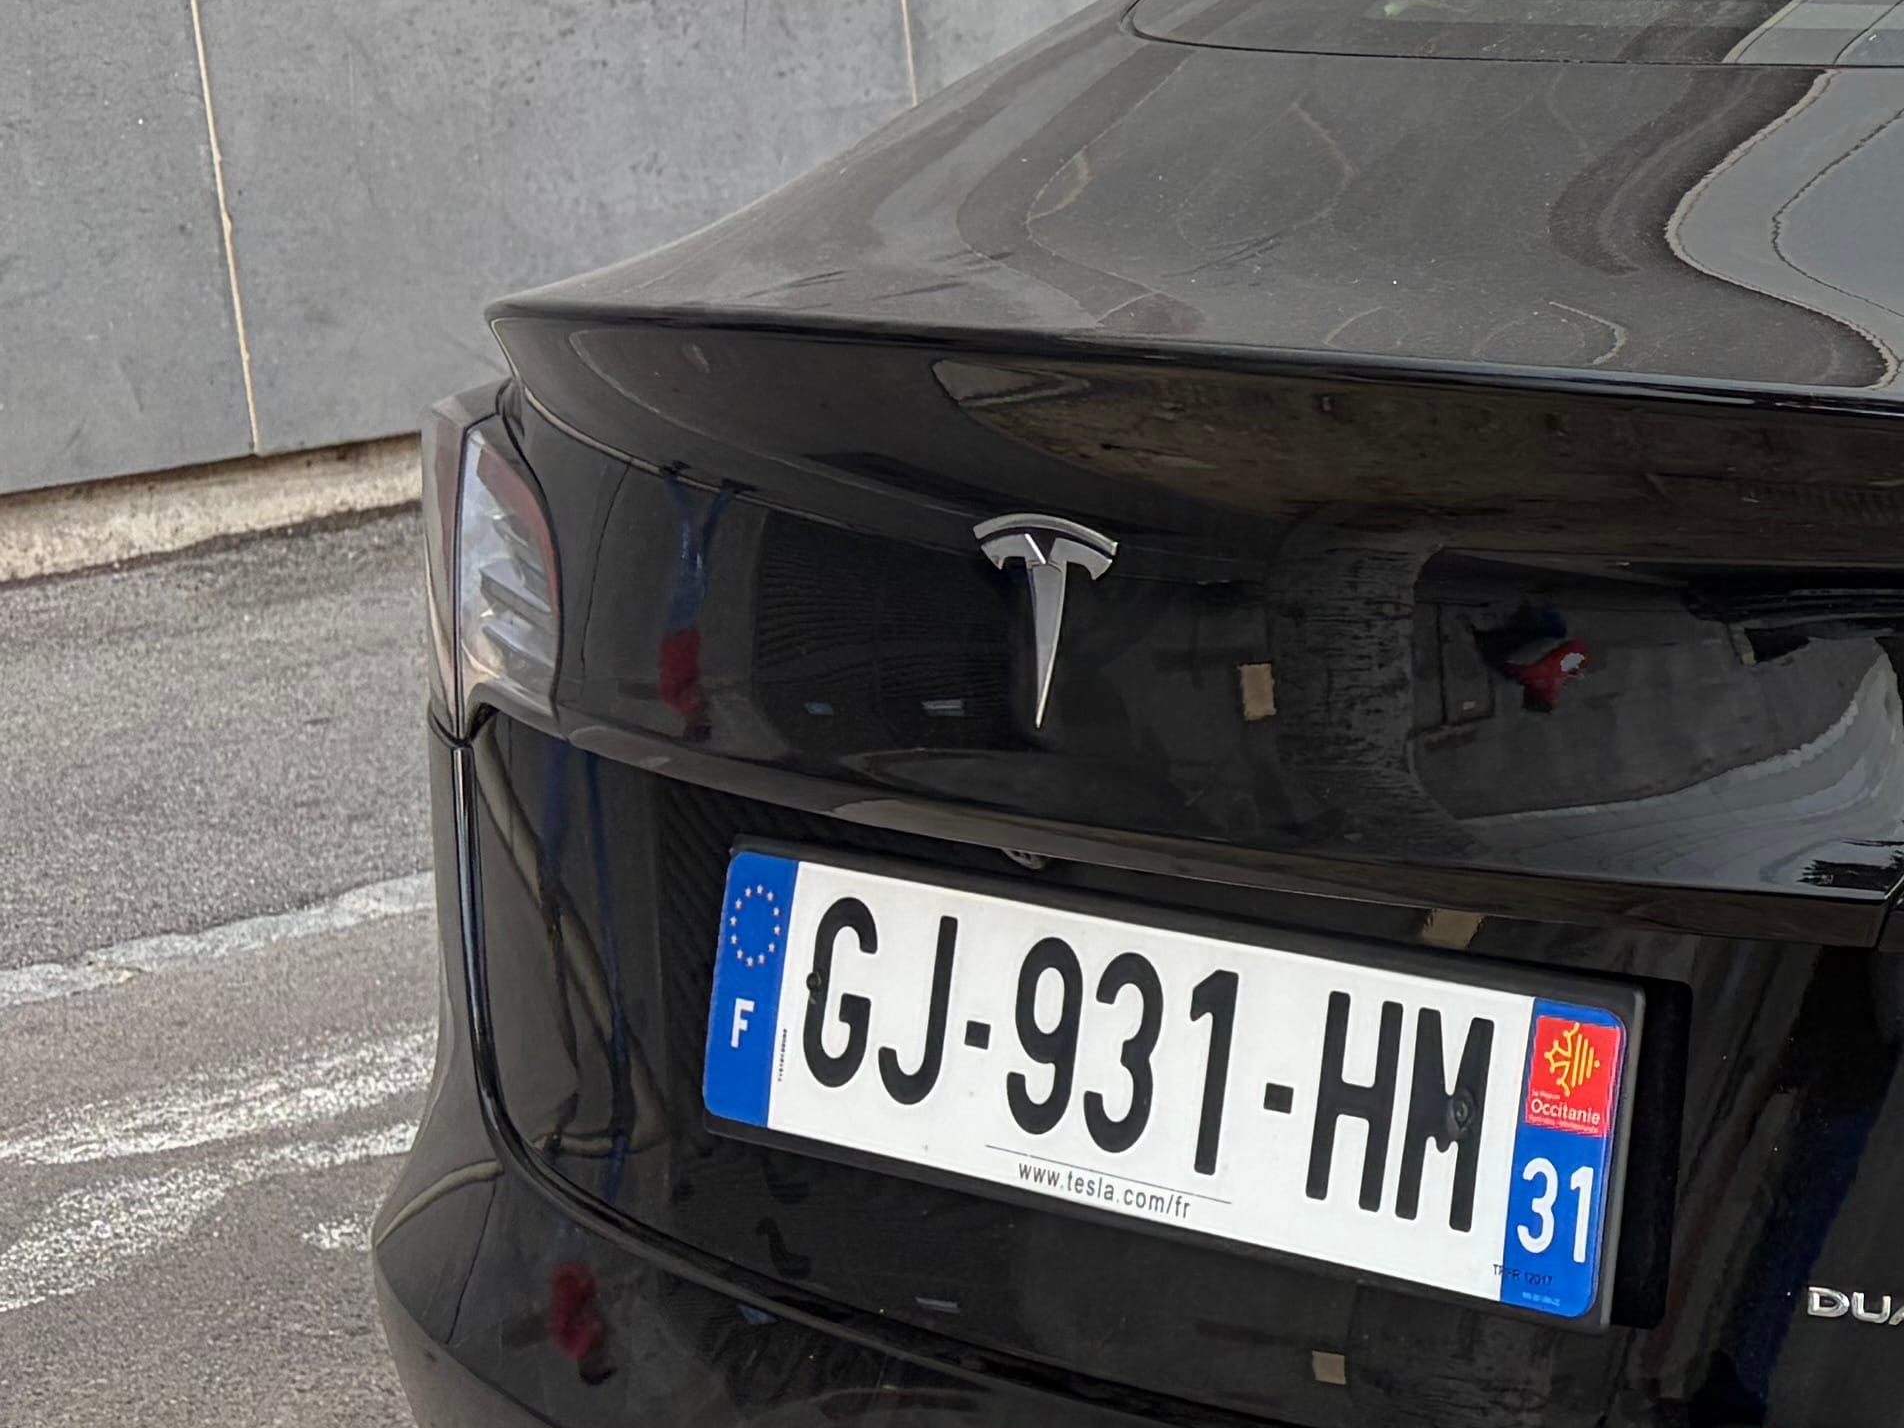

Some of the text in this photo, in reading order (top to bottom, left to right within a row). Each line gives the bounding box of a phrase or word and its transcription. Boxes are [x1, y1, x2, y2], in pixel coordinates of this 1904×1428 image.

[730, 999, 755, 1048] F
[802, 896, 1495, 1234] GJ-931-HM
[1531, 1097, 1601, 1126] Occitanie
[1018, 1162, 1192, 1219] www.tesla.com/fr
[1517, 1157, 1595, 1264] 31
